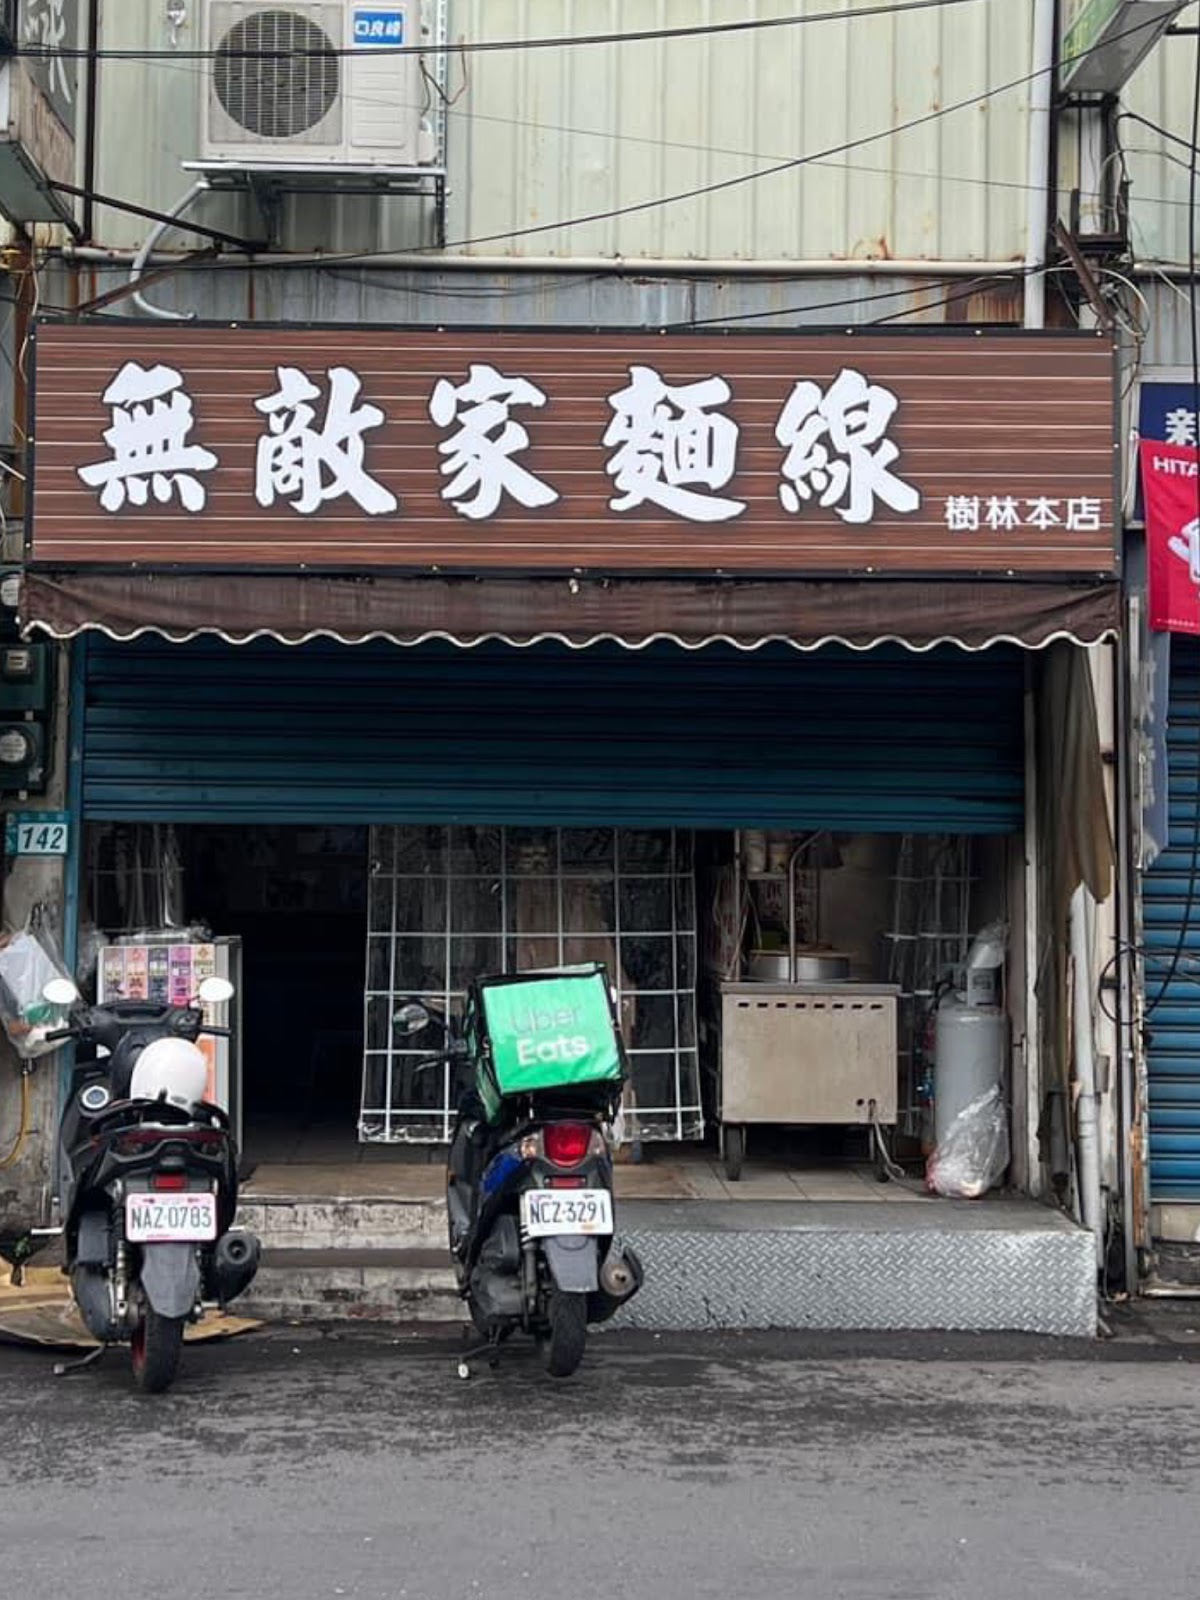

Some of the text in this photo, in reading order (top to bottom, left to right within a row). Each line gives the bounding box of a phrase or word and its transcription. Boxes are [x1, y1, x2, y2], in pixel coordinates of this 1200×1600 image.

[77, 361, 920, 524] 無敵家麵線
[944, 495, 1101, 532] 樹林本店
[22, 826, 64, 850] 142
[516, 1034, 591, 1066] Eats
